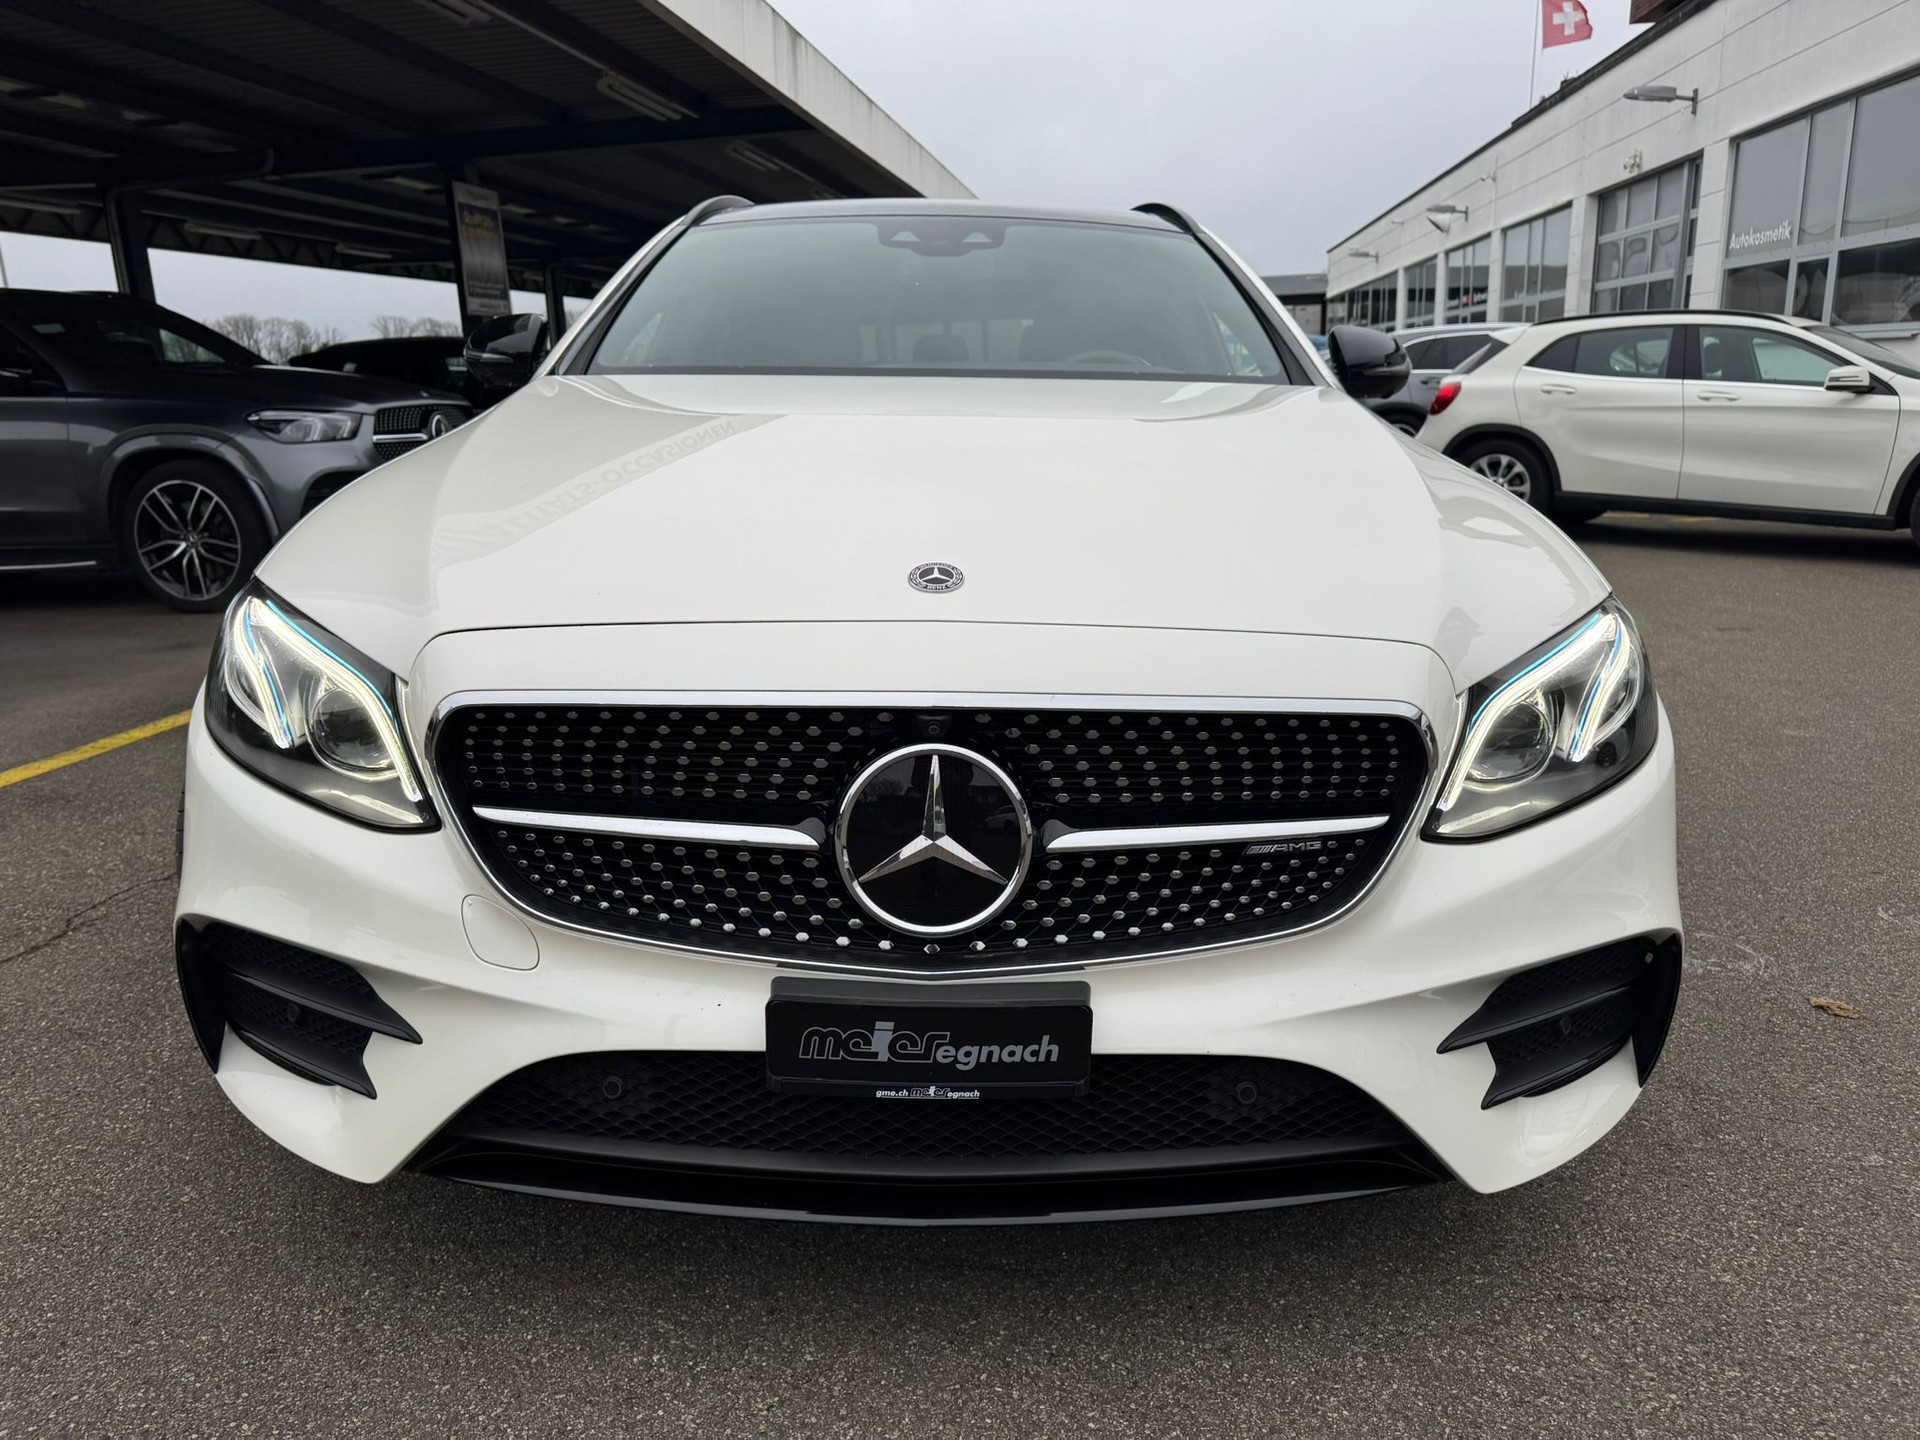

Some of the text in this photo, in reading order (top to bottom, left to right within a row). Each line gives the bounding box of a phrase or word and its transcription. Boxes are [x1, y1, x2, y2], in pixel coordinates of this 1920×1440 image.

[1729, 219, 1791, 251] Autokosmetik
[1268, 841, 1322, 854] AMG
[875, 1088, 909, 1098] gme.ch
